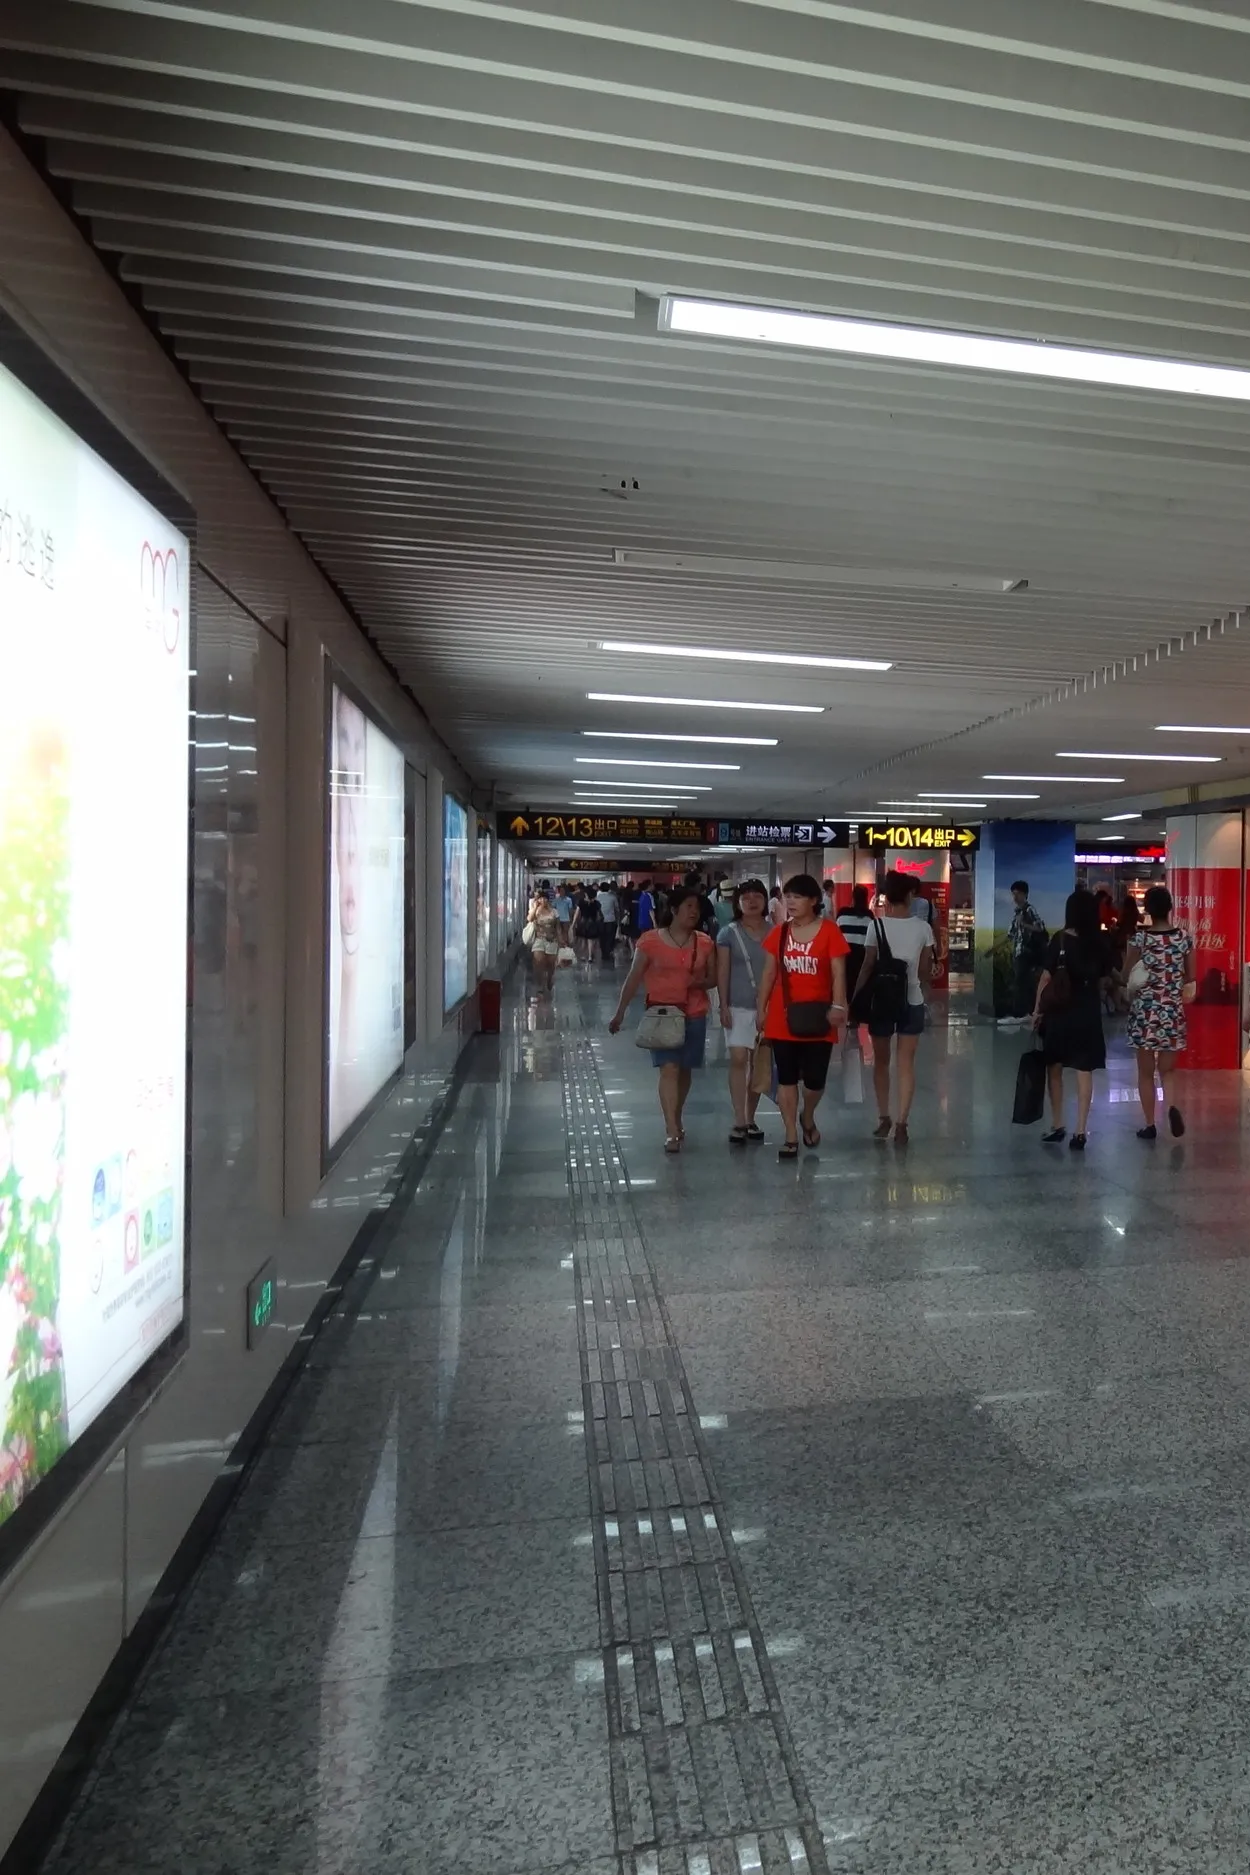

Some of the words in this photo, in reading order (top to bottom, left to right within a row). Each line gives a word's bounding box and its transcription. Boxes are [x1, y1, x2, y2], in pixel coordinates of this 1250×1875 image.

[594, 819, 617, 831] 出口
[745, 825, 792, 838] 进站检票
[934, 828, 955, 840] 出口
